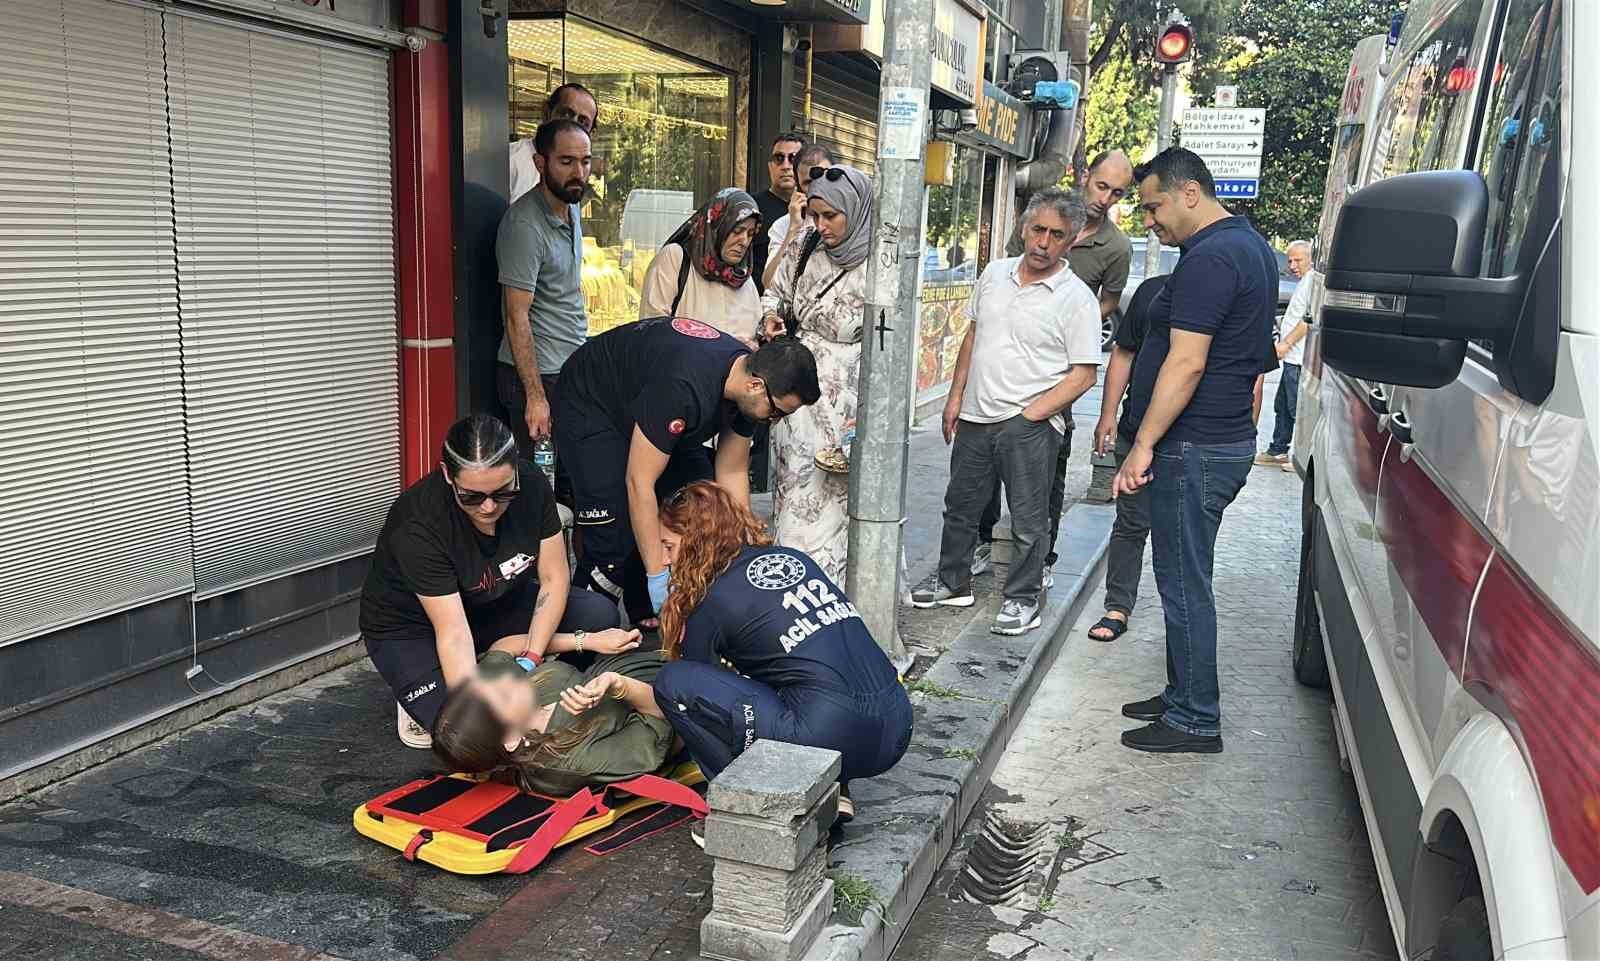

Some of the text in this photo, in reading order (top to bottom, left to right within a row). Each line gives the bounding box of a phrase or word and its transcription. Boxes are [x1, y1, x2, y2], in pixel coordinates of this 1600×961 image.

[1185, 112, 1215, 122] Bölge
[1184, 122, 1245, 130] Mahkemesi
[1184, 141, 1213, 149] Adalet
[1206, 160, 1256, 169] umhuriyet
[1215, 183, 1254, 192] nkara
[782, 578, 838, 615] 112
[779, 617, 822, 654] ACİL
